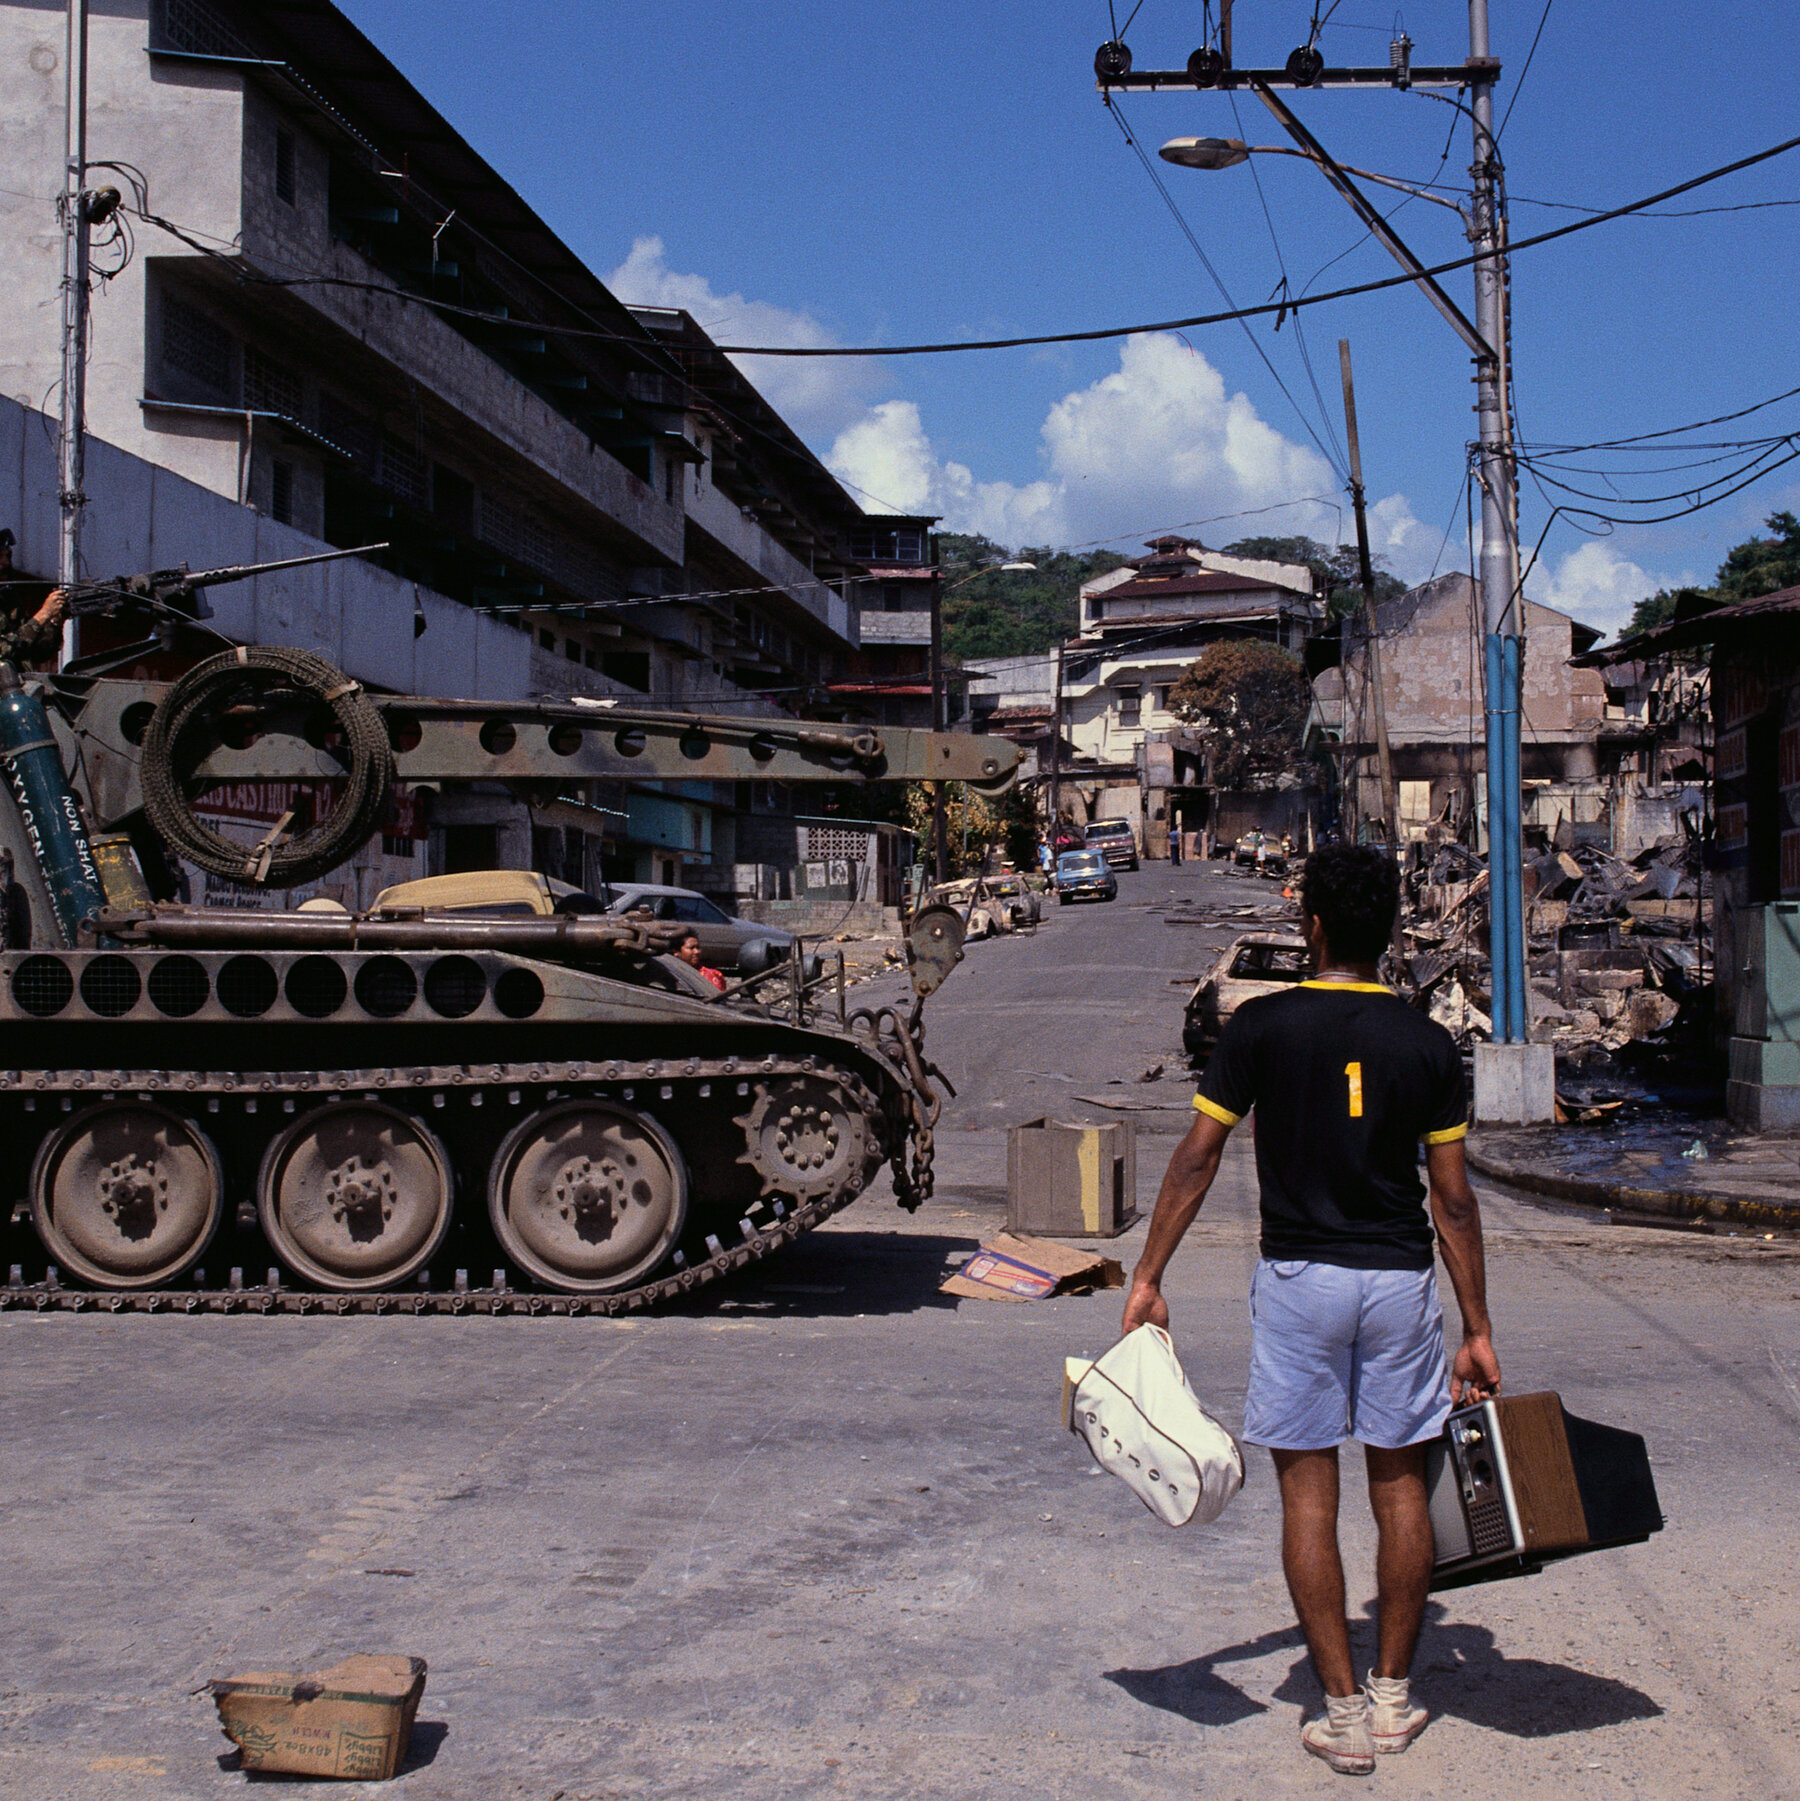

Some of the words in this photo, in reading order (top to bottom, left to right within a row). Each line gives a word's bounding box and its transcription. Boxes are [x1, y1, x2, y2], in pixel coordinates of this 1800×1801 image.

[61, 796, 82, 832] NON
[74, 838, 98, 884] SHAT
[1345, 1062, 1363, 1117] 1
